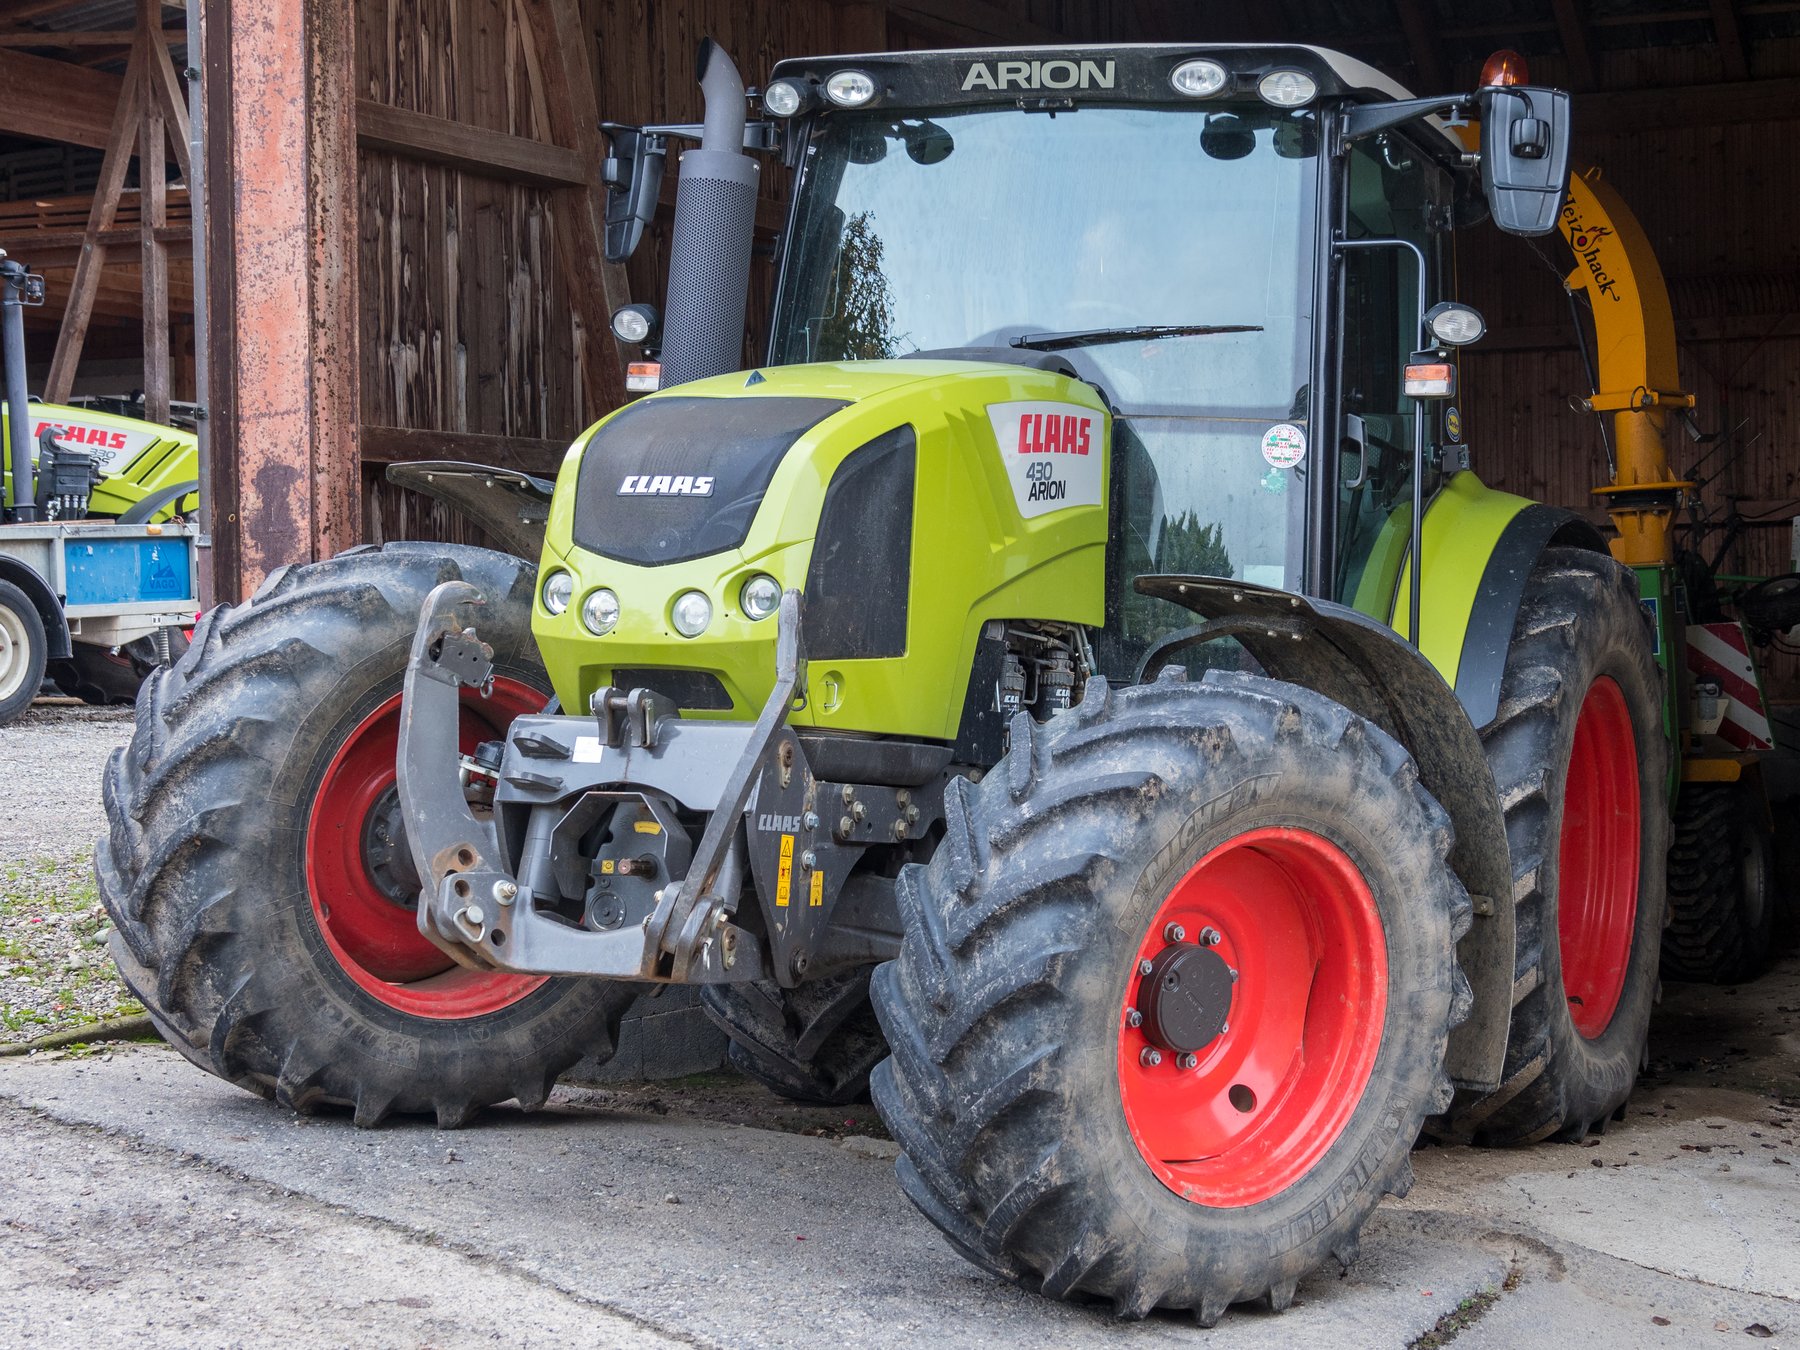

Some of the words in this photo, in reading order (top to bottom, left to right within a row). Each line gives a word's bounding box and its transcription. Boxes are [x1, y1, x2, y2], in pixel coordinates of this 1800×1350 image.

[961, 60, 1115, 91] ARION
[1018, 413, 1091, 455] CLAAS
[89, 447, 117, 459] 330
[1026, 461, 1053, 482] 430
[620, 475, 714, 494] CLAAS
[1028, 480, 1067, 501] ARION
[150, 579, 176, 589] VAGO
[758, 814, 800, 832] CLAAS
